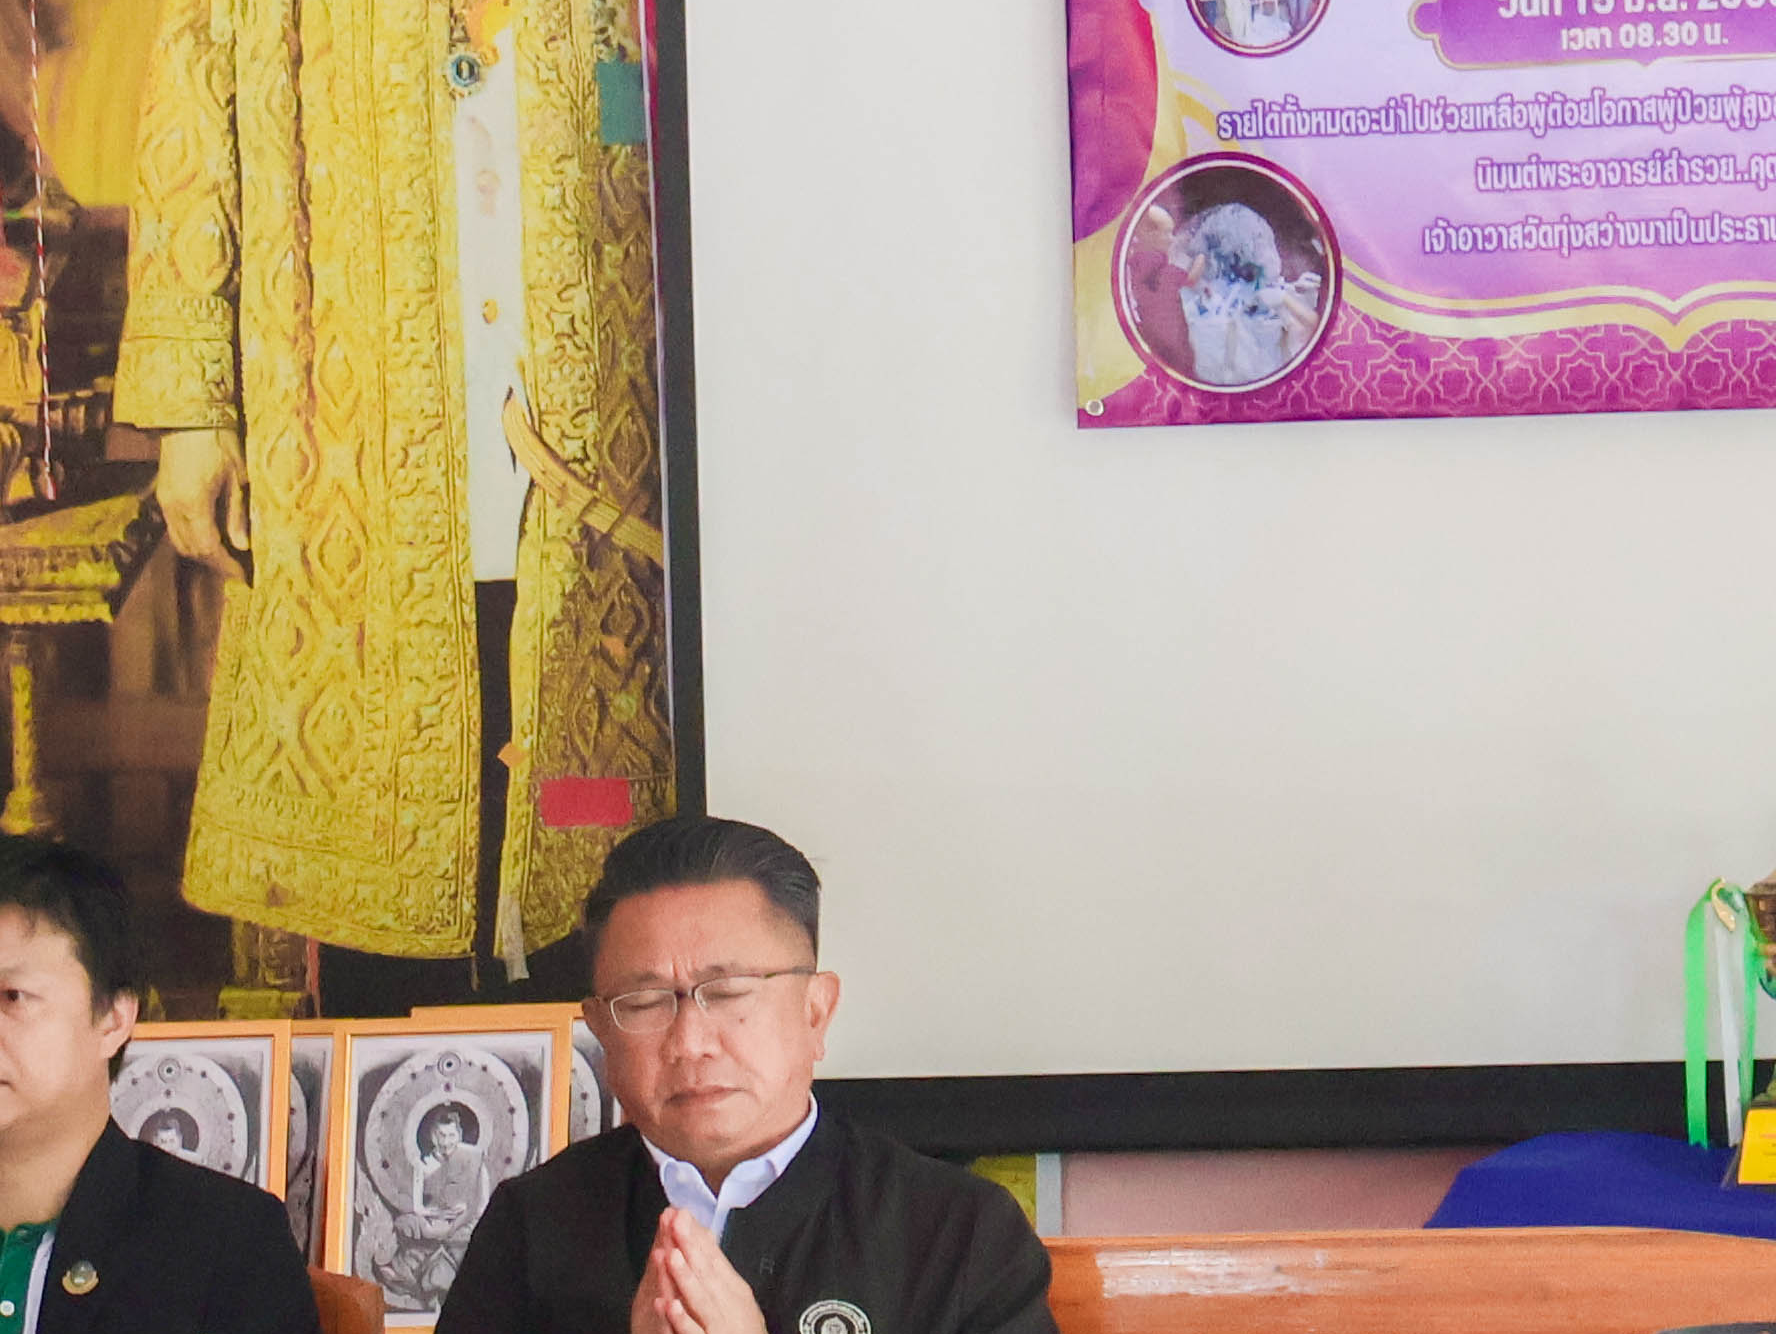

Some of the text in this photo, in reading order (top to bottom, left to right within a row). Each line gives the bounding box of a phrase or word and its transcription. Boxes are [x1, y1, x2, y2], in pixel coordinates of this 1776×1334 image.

[1561, 20, 1728, 50] เวลา 08.30 น.
